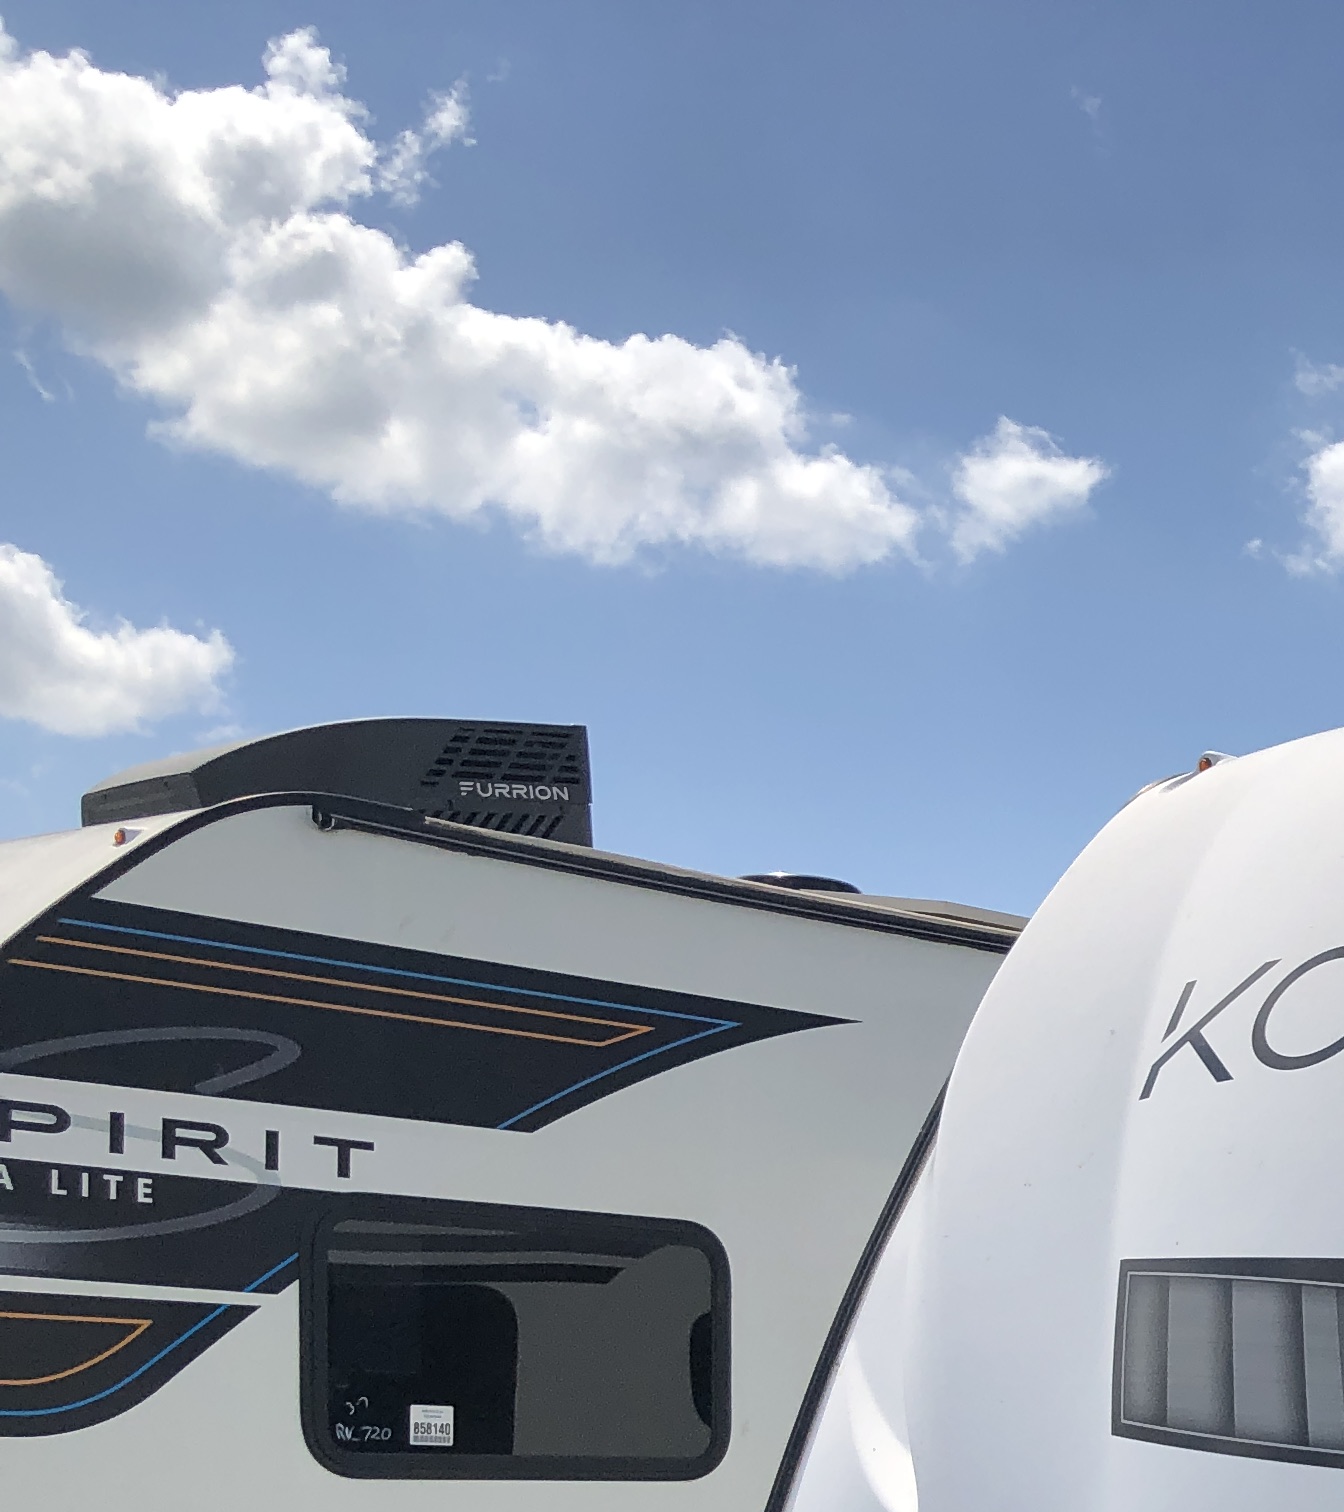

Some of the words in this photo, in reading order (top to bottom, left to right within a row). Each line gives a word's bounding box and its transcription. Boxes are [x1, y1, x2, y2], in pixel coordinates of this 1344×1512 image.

[458, 781, 569, 801] FURRION
[0, 1098, 375, 1180] PIRIT
[50, 1168, 154, 1204] LITE
[413, 1421, 451, 1436] 858140
